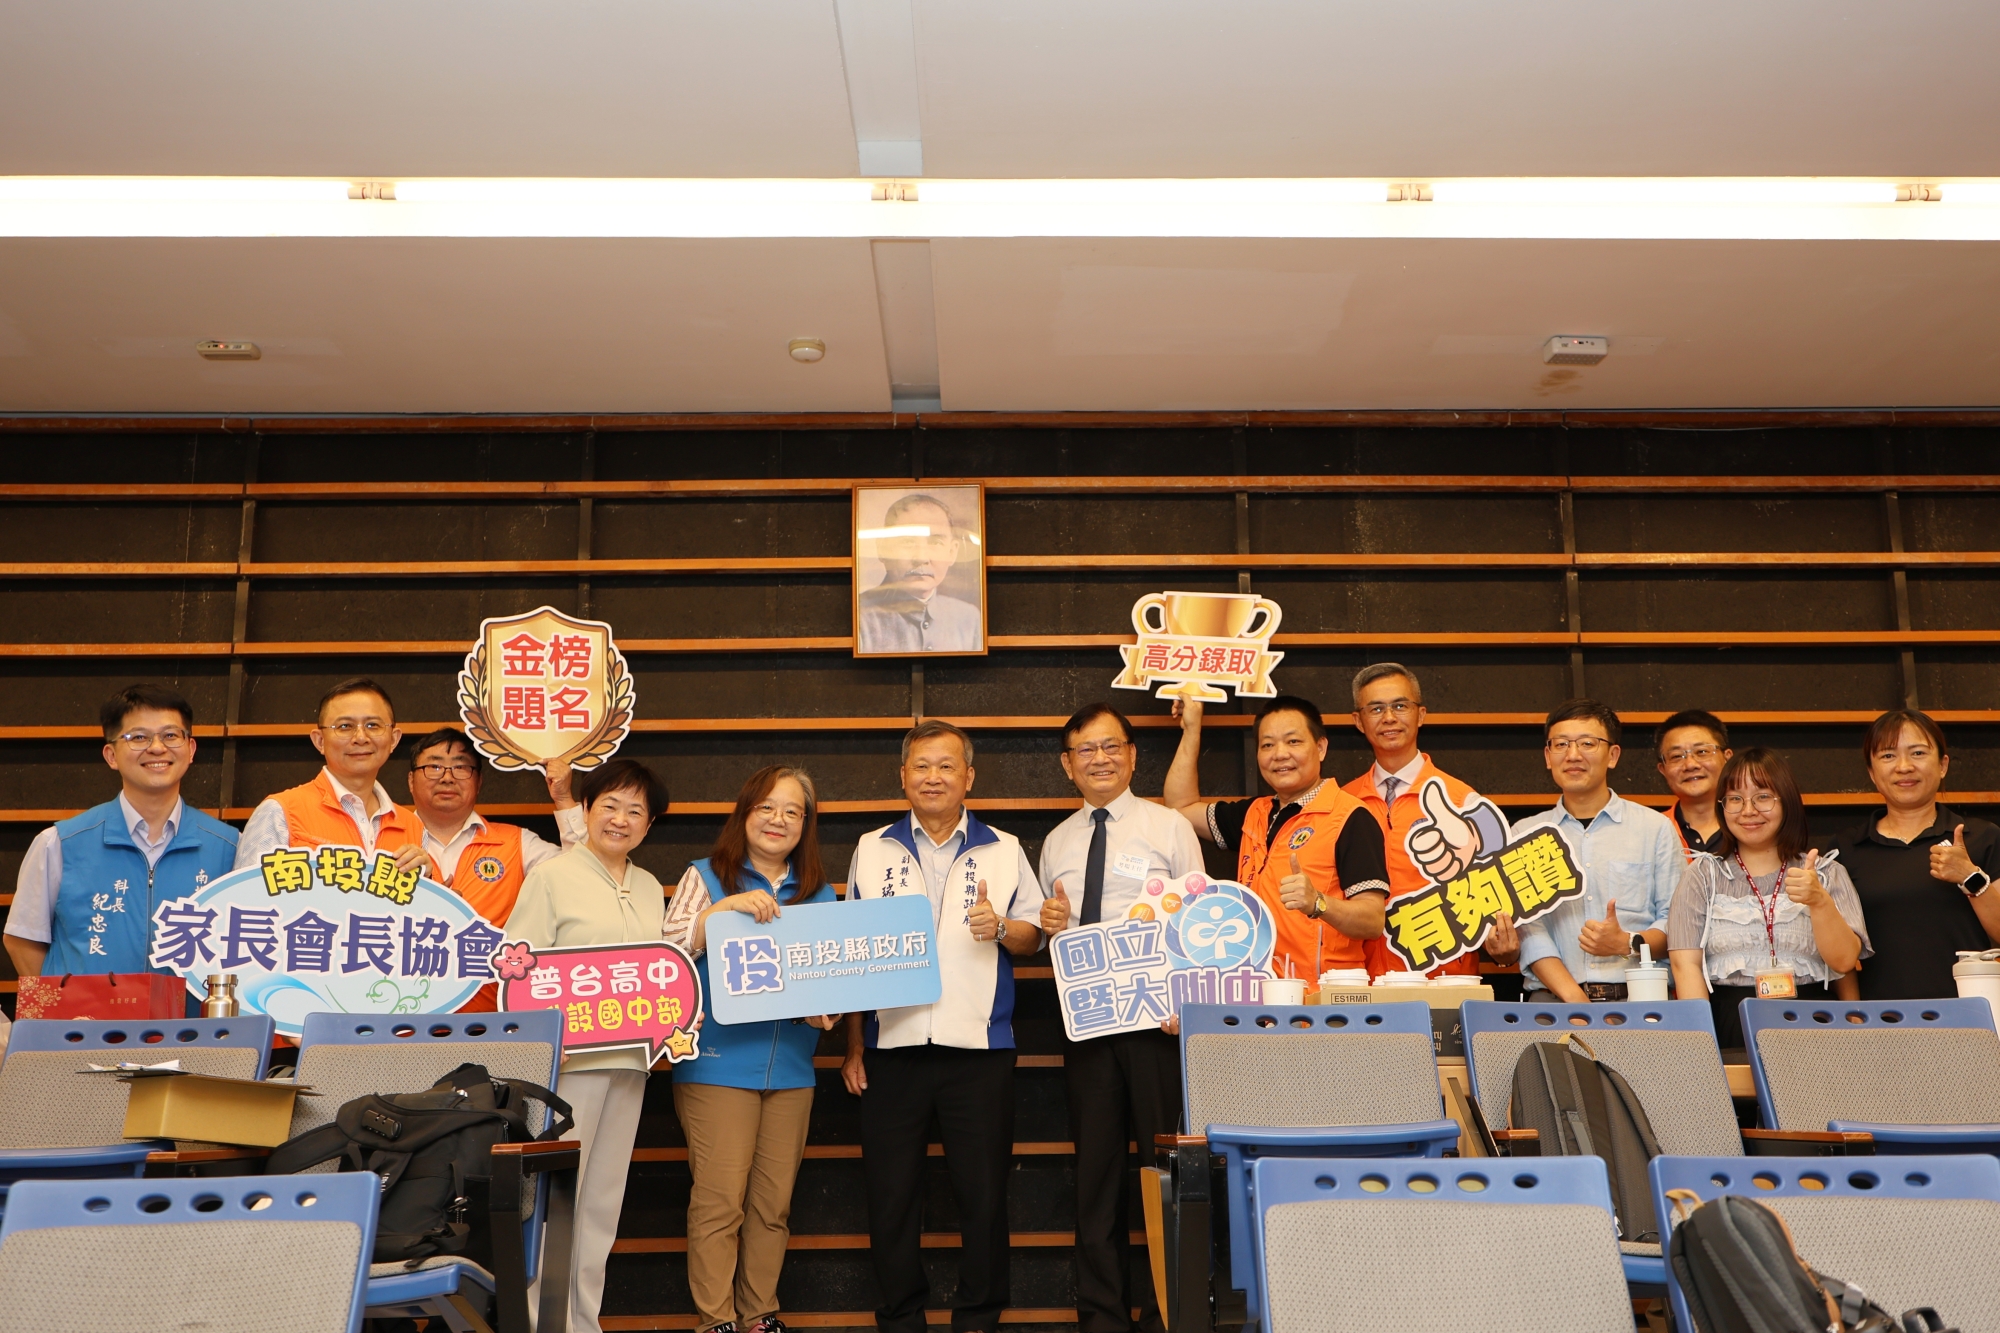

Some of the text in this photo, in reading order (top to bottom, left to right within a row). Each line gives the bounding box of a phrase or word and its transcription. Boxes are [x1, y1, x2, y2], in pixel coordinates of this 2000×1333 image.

[502, 633, 592, 679] 金榜
[1141, 644, 1257, 675] 高分錄取
[502, 686, 591, 731] 題名
[194, 868, 209, 893] 南
[262, 847, 422, 905] 南投縣
[899, 854, 911, 888] 副縣長
[111, 878, 129, 914] 科長
[1387, 832, 1577, 967] 有夠讚
[88, 892, 113, 956] 紀忠良
[155, 902, 506, 980] 家長會長協會
[785, 930, 928, 969] 南投縣政府
[788, 959, 931, 981] Nantou County Government
[1056, 919, 1165, 981] 國立
[529, 957, 680, 1000] 普台高中
[1064, 966, 1267, 1034] 暨大附中
[1334, 994, 1369, 1004] ES1RMR
[546, 994, 684, 1034] 設國中部
